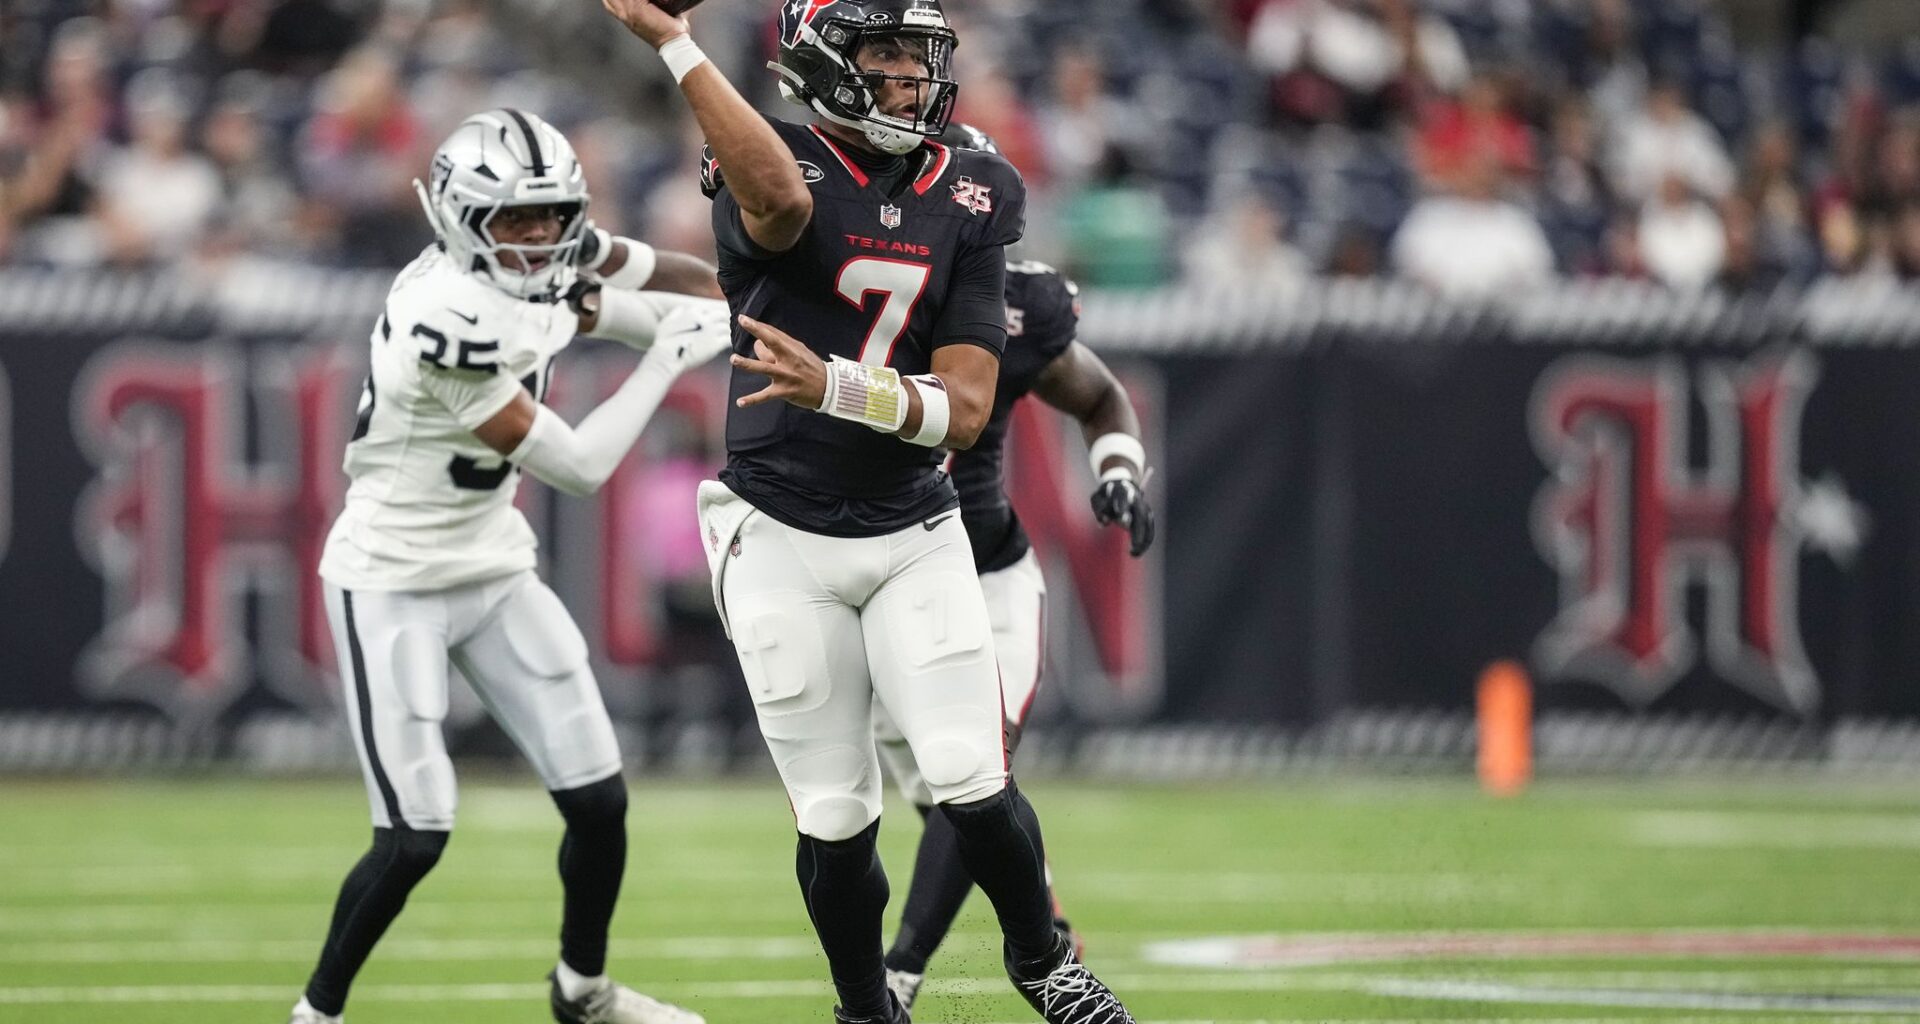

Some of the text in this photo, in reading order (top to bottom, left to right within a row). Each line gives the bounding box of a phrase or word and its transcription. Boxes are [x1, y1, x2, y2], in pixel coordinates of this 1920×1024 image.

[953, 178, 992, 213] 25
[882, 213, 898, 227] NFL
[845, 234, 930, 256] TEXANS
[833, 255, 932, 368] 7
[1005, 306, 1025, 336] 5
[411, 323, 498, 374] 35
